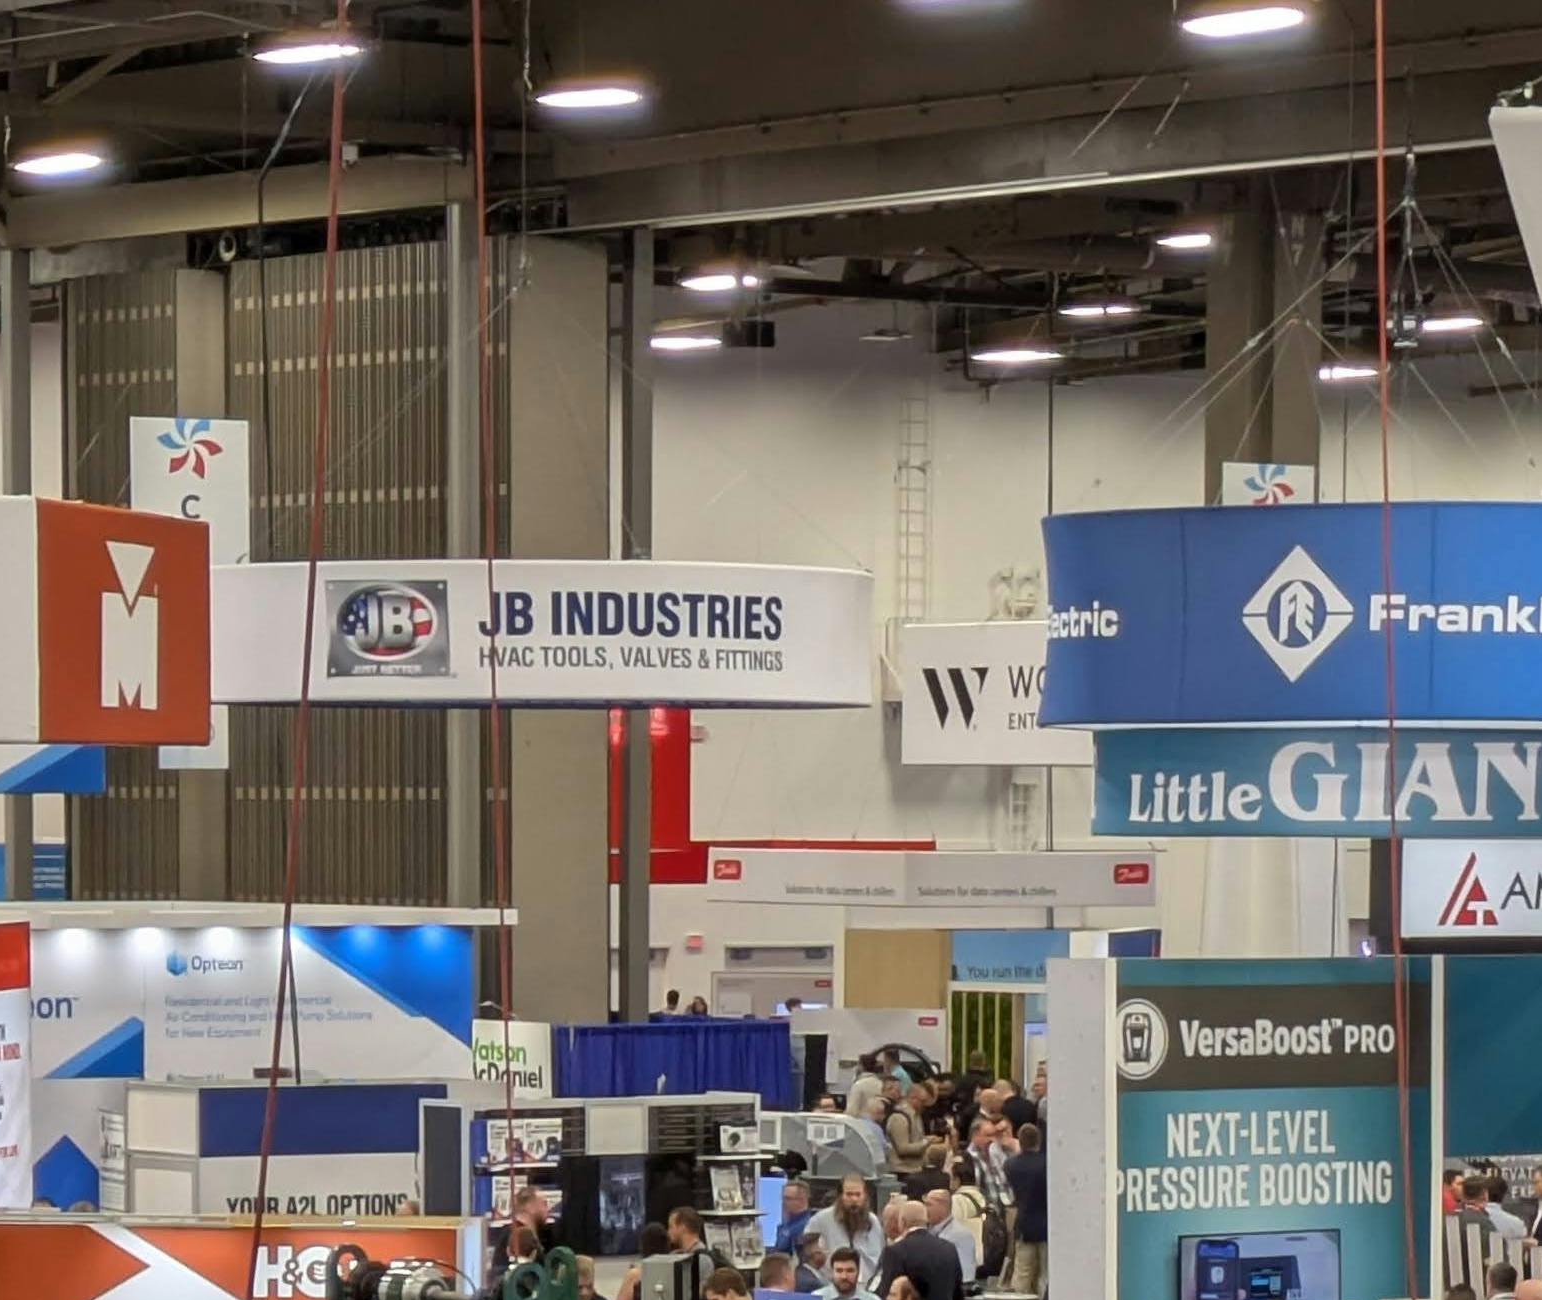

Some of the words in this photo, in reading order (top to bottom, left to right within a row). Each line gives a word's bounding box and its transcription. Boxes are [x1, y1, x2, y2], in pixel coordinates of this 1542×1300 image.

[478, 591, 534, 638] JB
[550, 591, 784, 641] INDUSTRIES
[478, 645, 535, 668] HVAC
[542, 645, 614, 670] TOOLS,
[620, 646, 692, 668] VALVES
[697, 648, 710, 668] &
[715, 650, 784, 672] FITTINGS
[1129, 771, 1262, 824] Little
[32, 998, 72, 1020] on
[475, 1037, 527, 1065] atson
[1344, 1024, 1396, 1053] PRO
[1165, 1109, 1336, 1160] NEXT-LEVEL
[1258, 1160, 1393, 1208] BOOSTING
